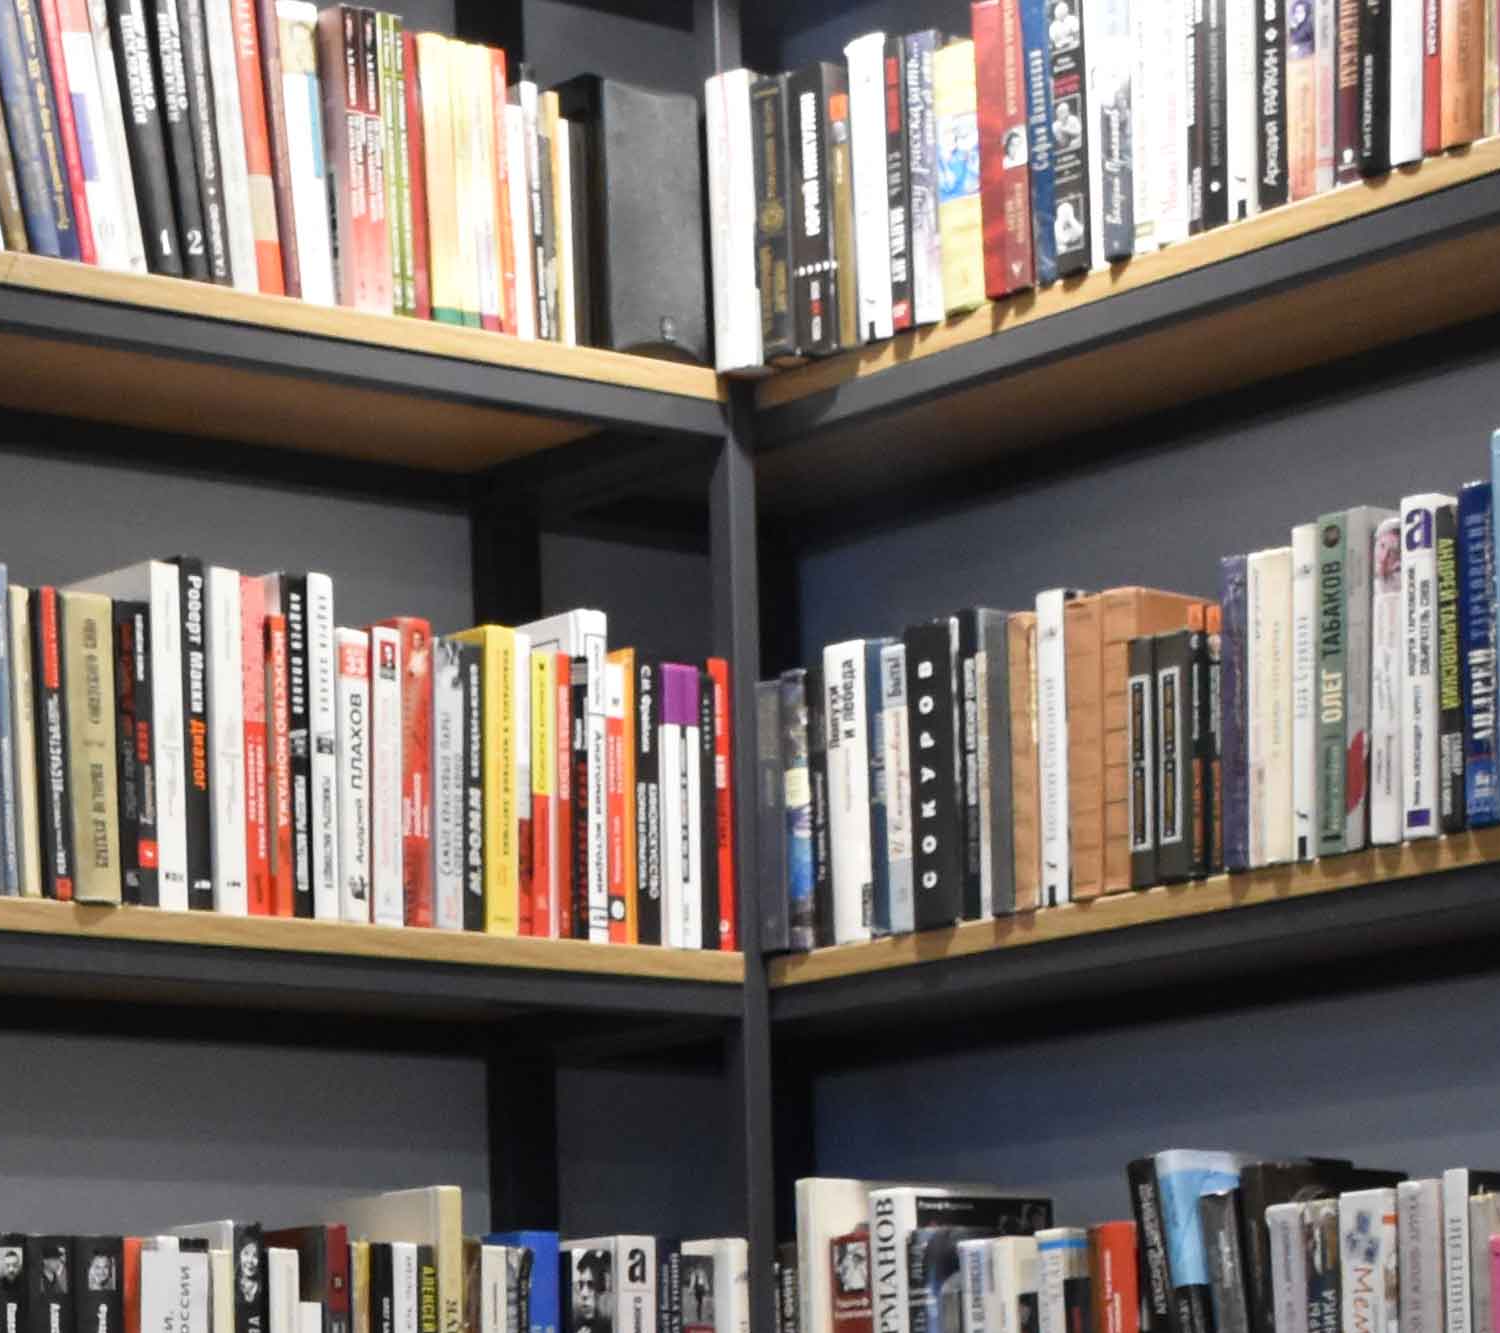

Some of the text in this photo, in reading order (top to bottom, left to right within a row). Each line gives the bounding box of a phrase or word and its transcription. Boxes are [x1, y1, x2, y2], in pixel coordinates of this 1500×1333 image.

[1262, 48, 1277, 115] РАЙКИН
[188, 575, 207, 789] Роберт Макки Диалог
[1321, 561, 1341, 724] ОЛЕГ ТАБАКОВ
[272, 631, 289, 827] ИСКУССТВО МОНТАЖА
[350, 693, 363, 789] ПЛАХОВ
[918, 661, 937, 889] СОКУРОВ
[422, 1266, 435, 1332] АЛЕКСЕЙ
